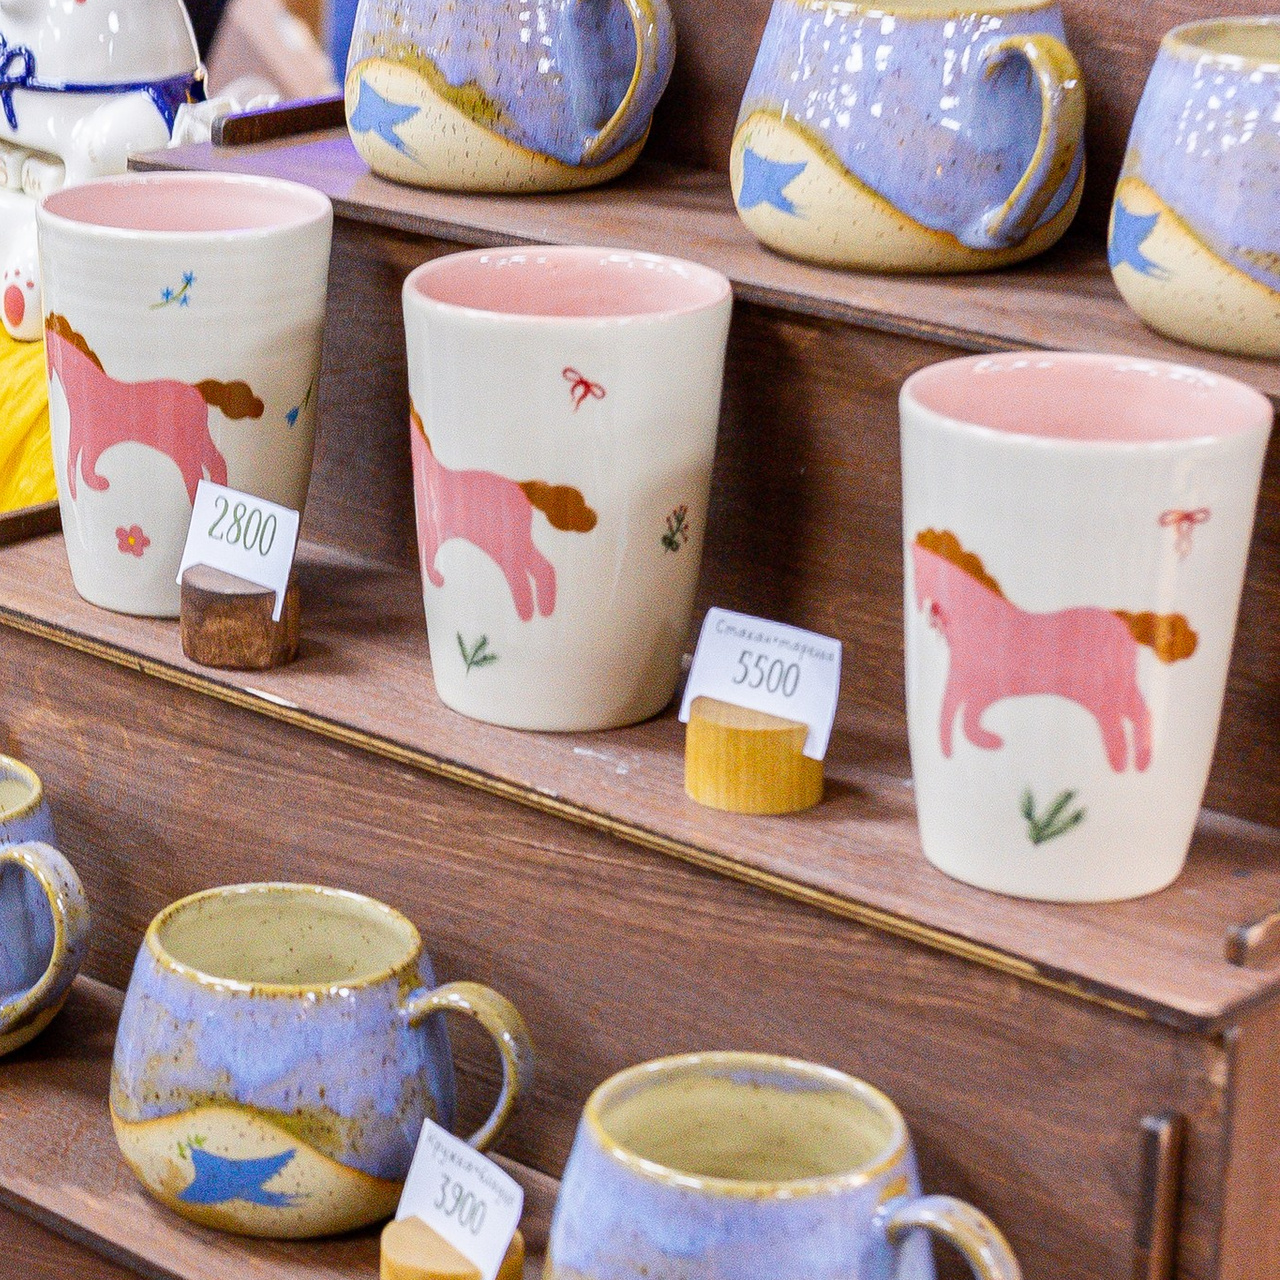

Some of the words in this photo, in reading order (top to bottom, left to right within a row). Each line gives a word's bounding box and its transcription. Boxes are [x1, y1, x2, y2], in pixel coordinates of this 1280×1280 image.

[207, 495, 278, 557] 2800
[731, 649, 801, 698] 5500
[433, 1172, 489, 1237] 3900
